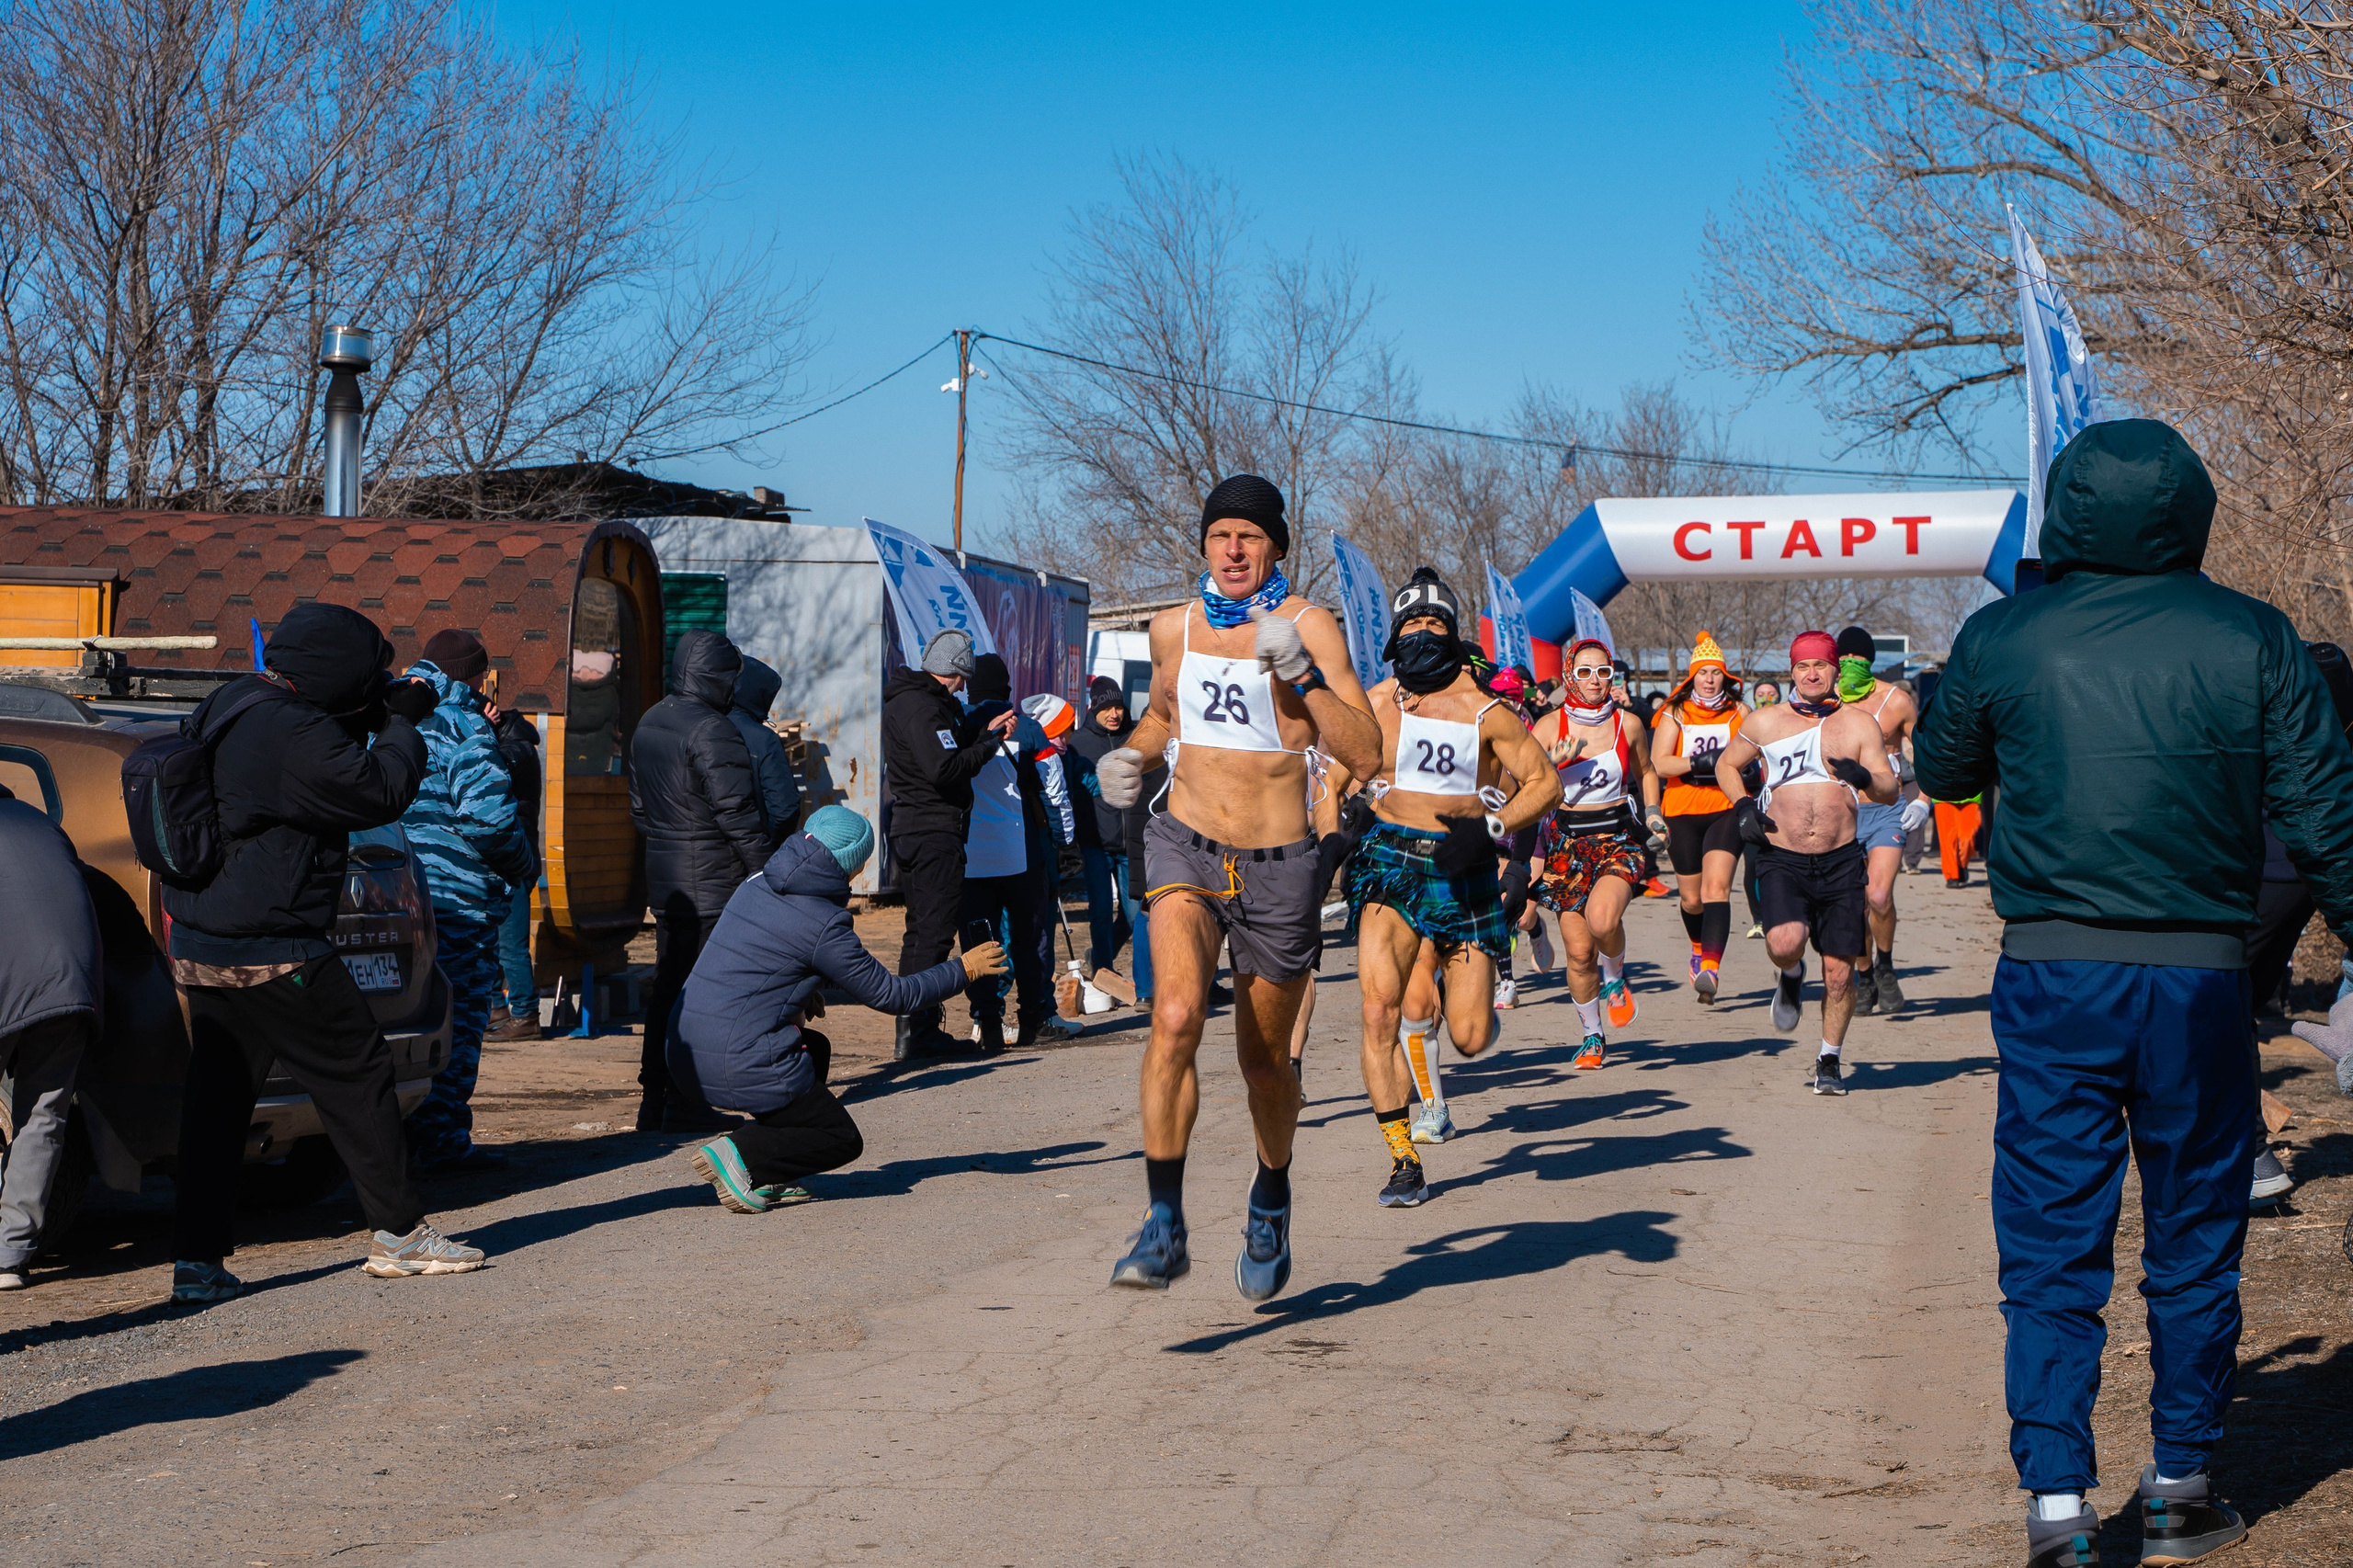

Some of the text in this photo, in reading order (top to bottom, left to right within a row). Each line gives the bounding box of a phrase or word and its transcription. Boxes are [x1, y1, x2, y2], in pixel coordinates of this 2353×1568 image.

[1673, 516, 1931, 562] СТАРТ
[1202, 680, 1249, 725] 26
[1416, 739, 1455, 775] 28
[1693, 736, 1719, 756] 30
[1779, 749, 1807, 781] 27
[326, 931, 399, 947] USTER
